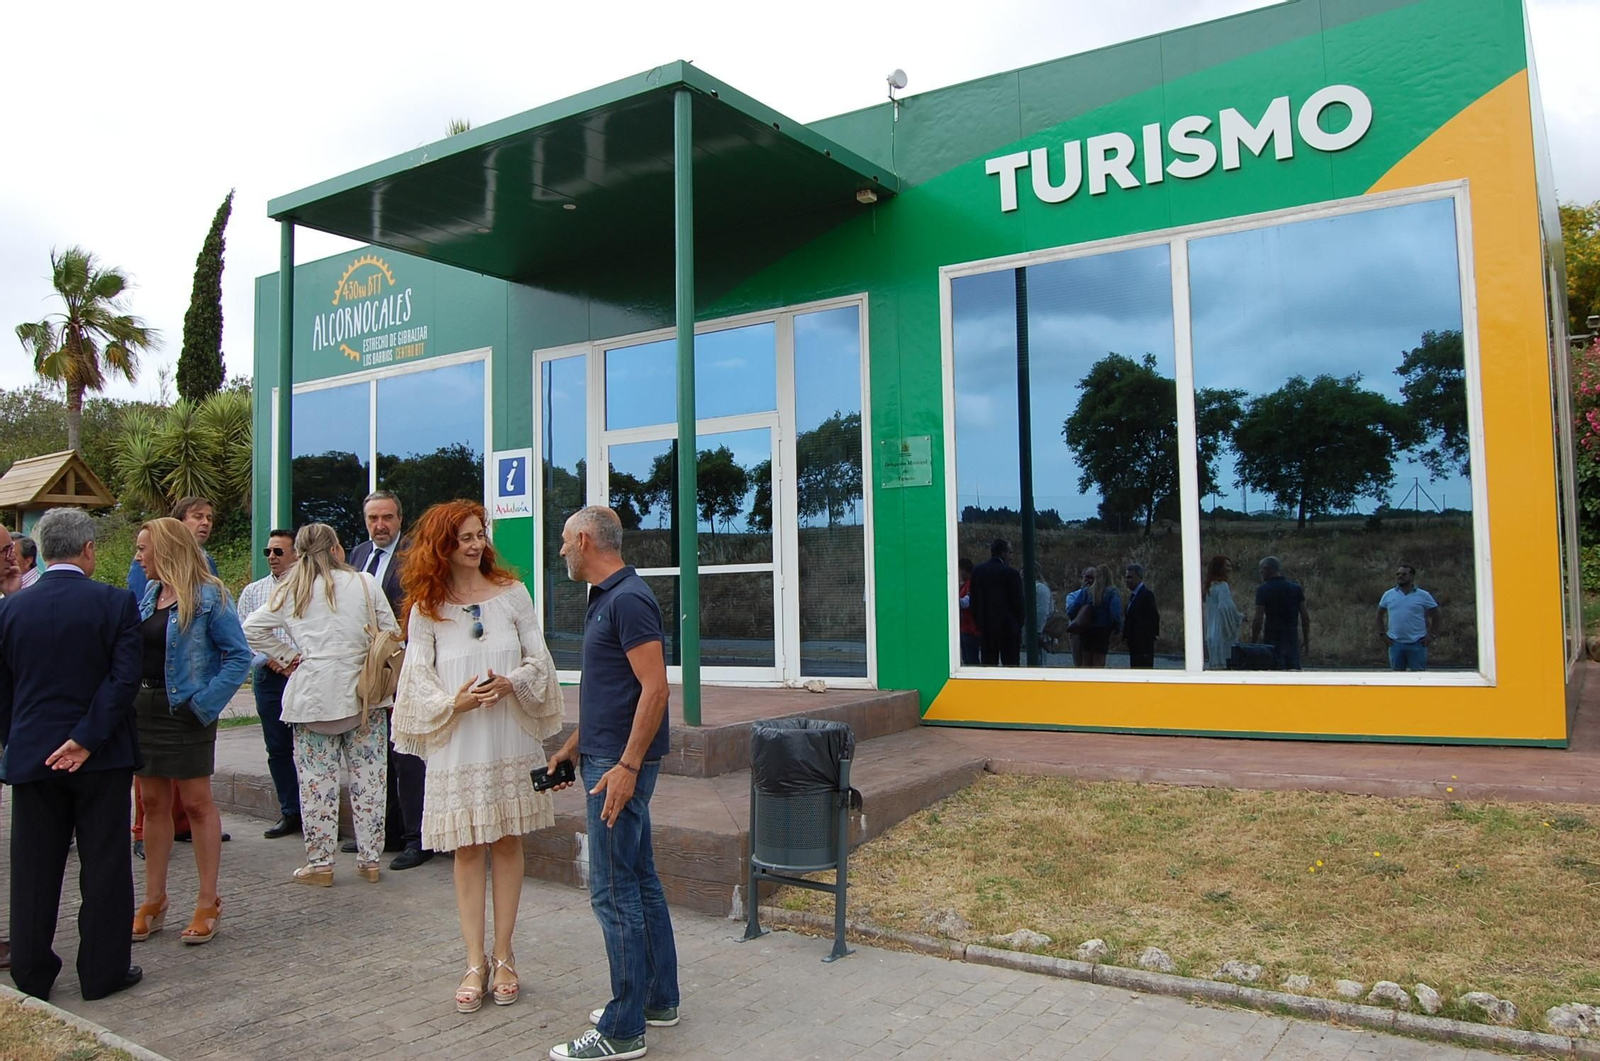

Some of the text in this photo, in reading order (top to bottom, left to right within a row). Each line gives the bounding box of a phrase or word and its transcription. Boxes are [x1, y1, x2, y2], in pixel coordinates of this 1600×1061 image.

[985, 84, 1373, 212] TURISMO
[367, 273, 382, 297] BTT
[313, 288, 412, 351] ALCORNOCALES
[363, 325, 428, 353] ESTRECHO DE GIBRALTAR
[363, 353, 372, 366] LOS
[372, 349, 393, 365] BARRIOS
[395, 346, 413, 361] CENTRO
